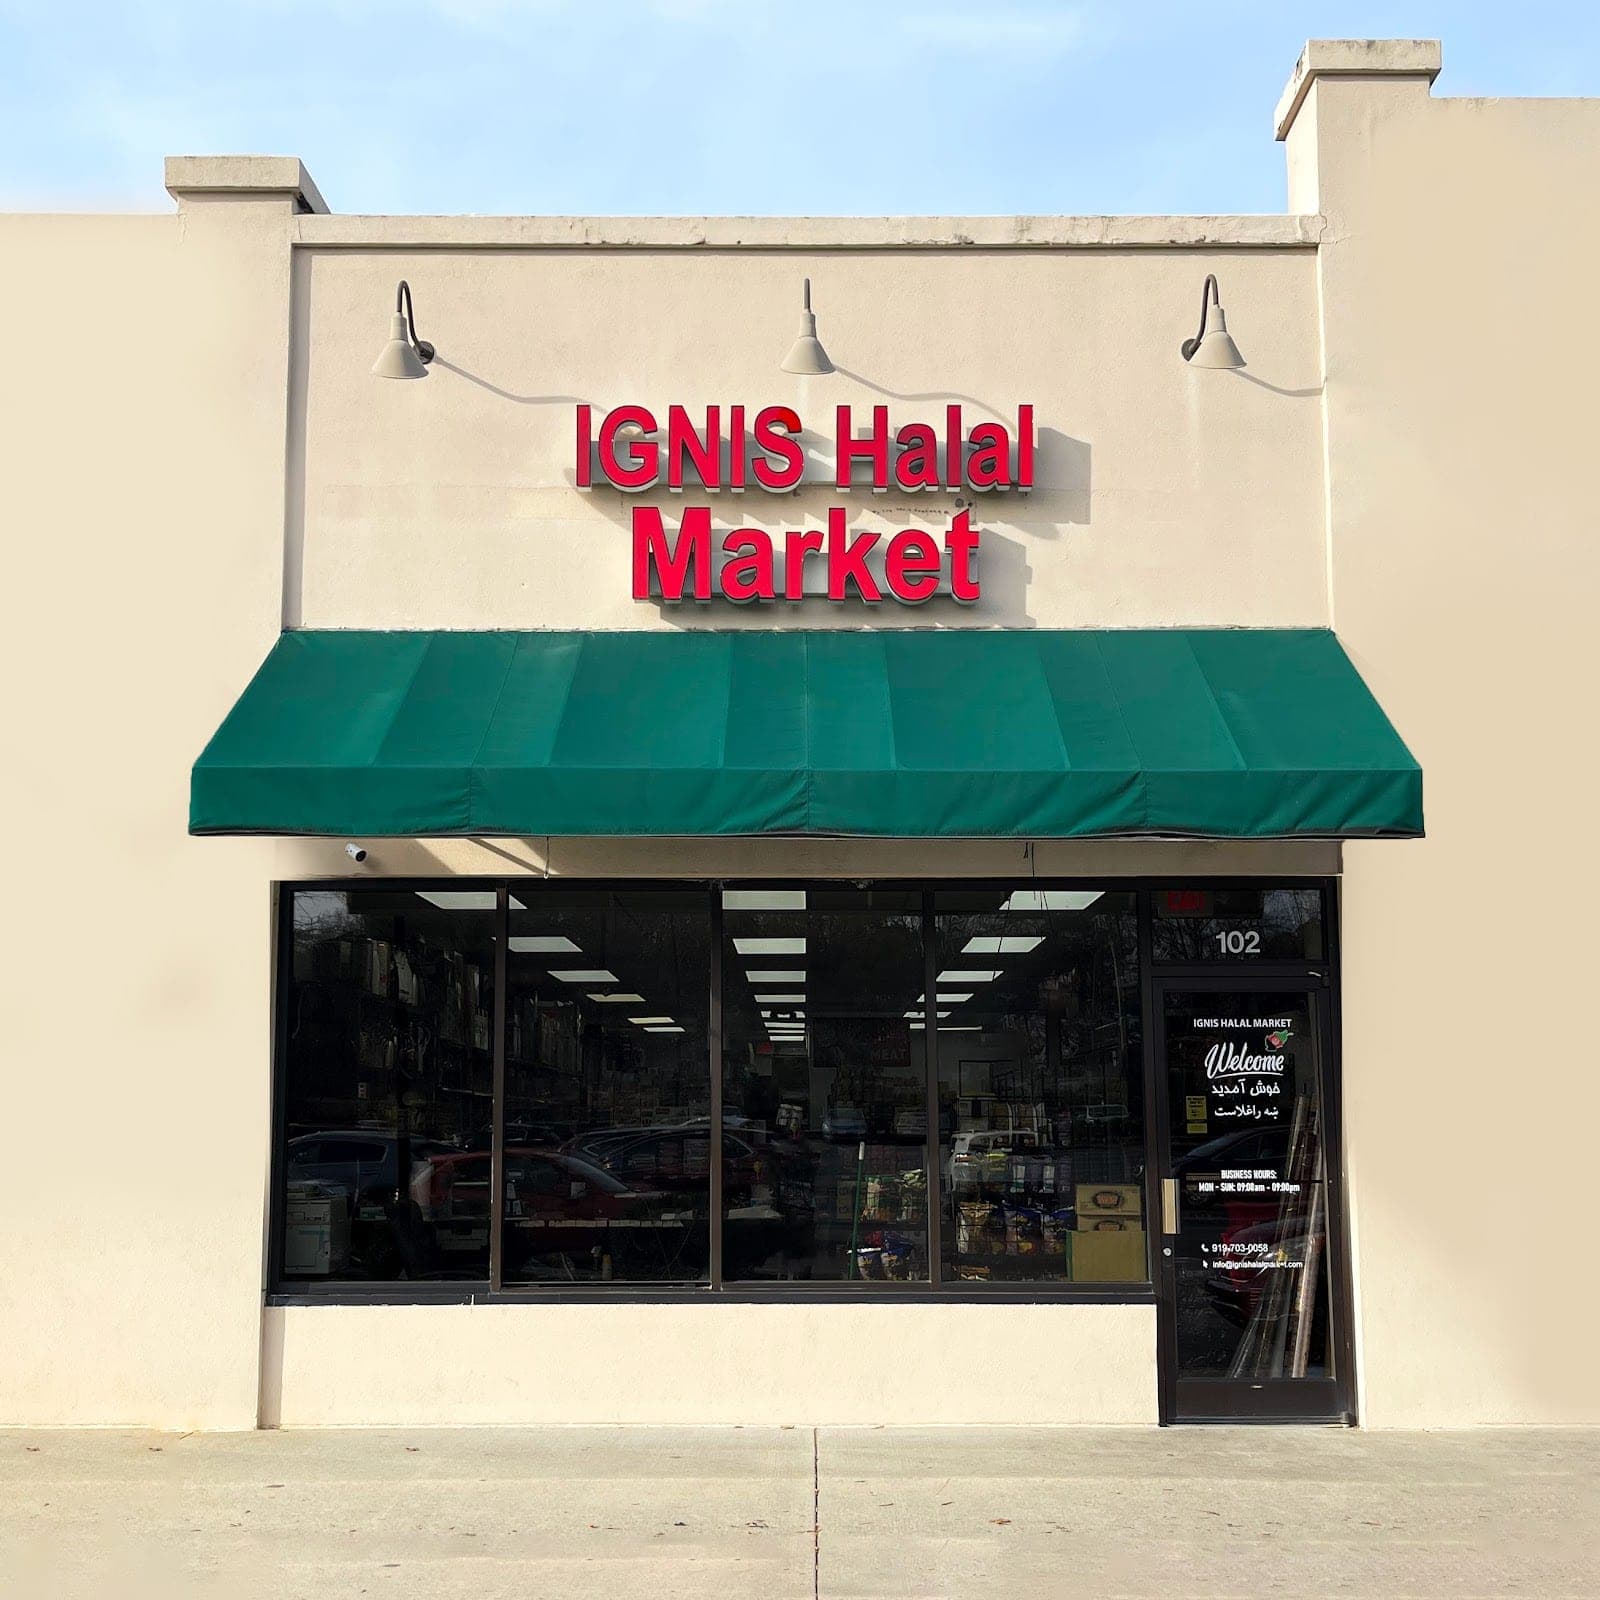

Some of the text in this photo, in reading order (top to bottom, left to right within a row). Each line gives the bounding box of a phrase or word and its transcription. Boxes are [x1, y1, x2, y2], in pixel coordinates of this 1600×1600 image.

[576, 404, 1034, 493] IGNIS Halal
[632, 507, 981, 604] Market
[1216, 931, 1261, 954] 102
[1193, 1018, 1293, 1028] IGNIS HALAL MARKET
[1204, 1041, 1285, 1079] Welcome
[1249, 1079, 1281, 1097] خوش
[1220, 1169, 1278, 1180] BUSINESS HOURS:
[1198, 1182, 1214, 1192] MON
[1220, 1182, 1236, 1192] SUN:
[1236, 1182, 1266, 1192] 09:00am
[1271, 1182, 1301, 1194] 09:00pm
[1211, 1243, 1269, 1253] 919-703-0058
